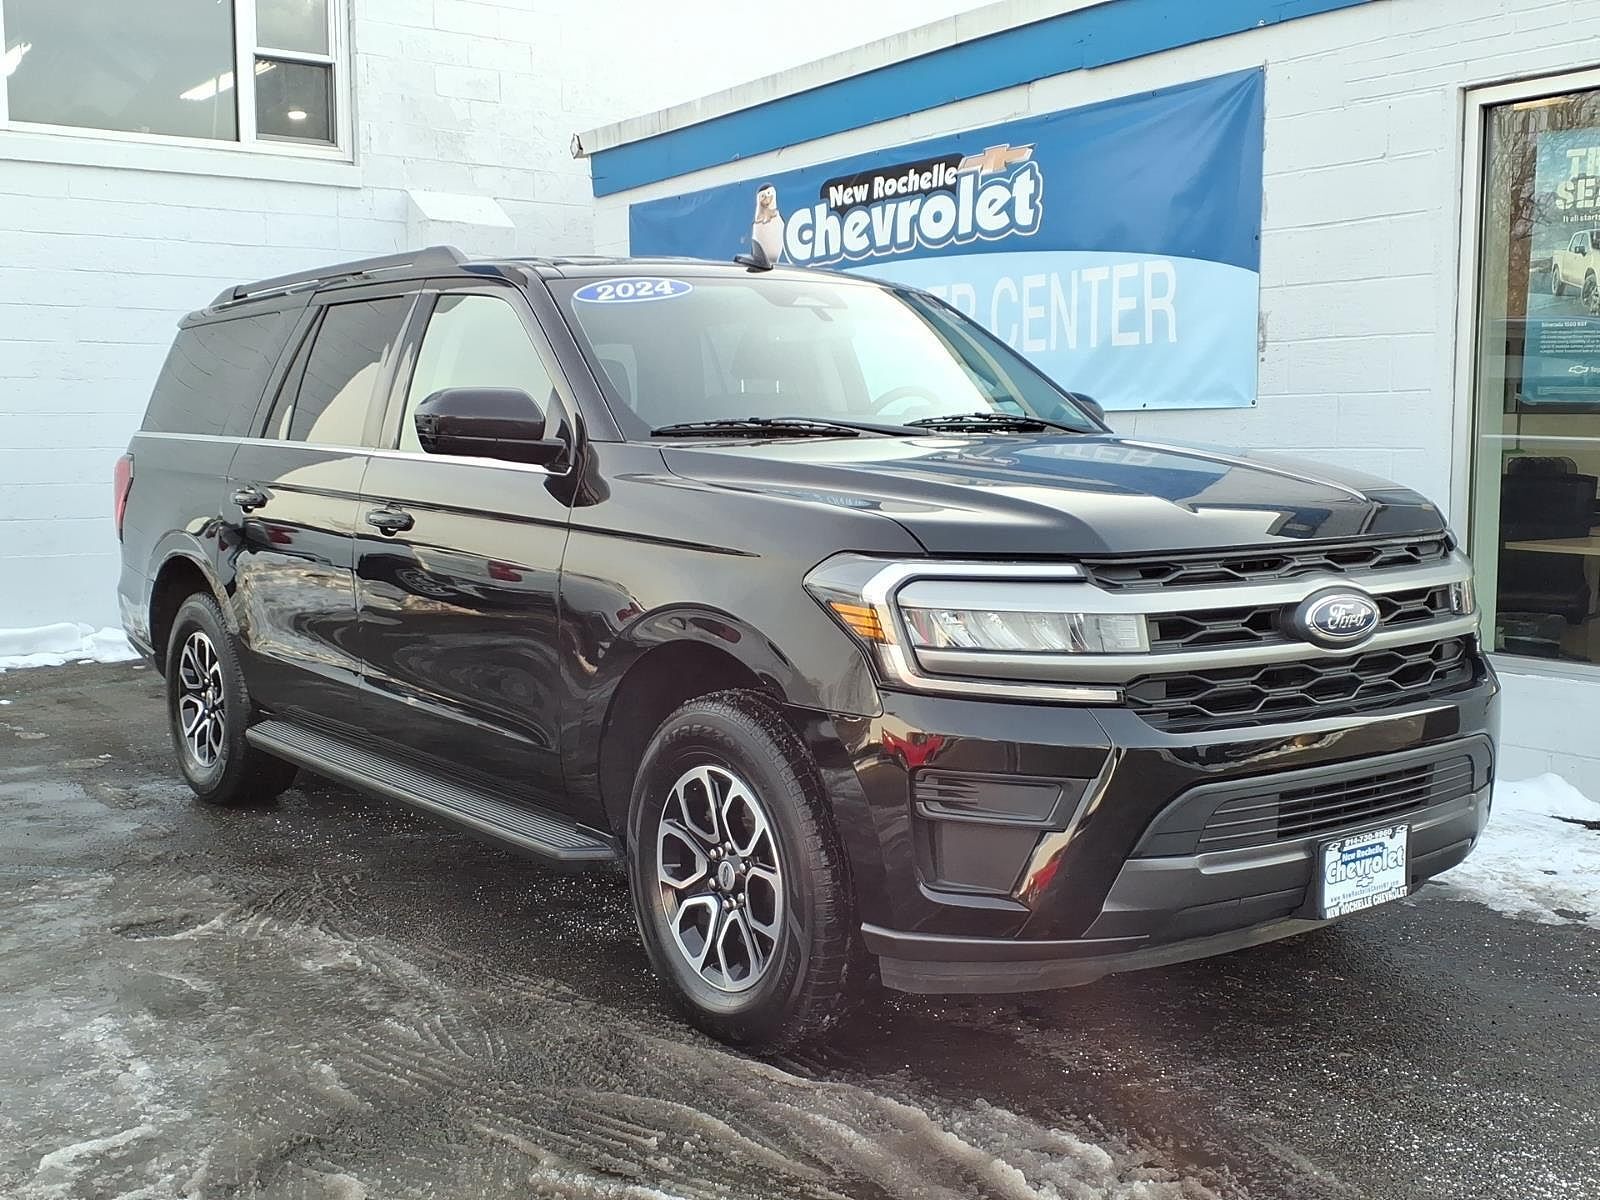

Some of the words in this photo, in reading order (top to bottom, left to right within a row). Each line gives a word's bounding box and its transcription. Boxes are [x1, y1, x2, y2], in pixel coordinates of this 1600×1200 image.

[829, 184, 870, 208] New
[873, 163, 958, 200] Rochelle
[1556, 178, 1600, 210] SE
[785, 168, 1036, 261] Chevrolet
[596, 280, 675, 300] 2024
[990, 260, 1178, 352] CENTER
[1327, 603, 1372, 630] Ford
[1325, 845, 1405, 885] Chevrolet
[1341, 851, 1356, 862] New
[1356, 844, 1384, 859] Rochelle
[1326, 905, 1340, 919] NEW
[1340, 896, 1373, 915] ROCHELLE
[1373, 886, 1408, 906] CHEVROLET
